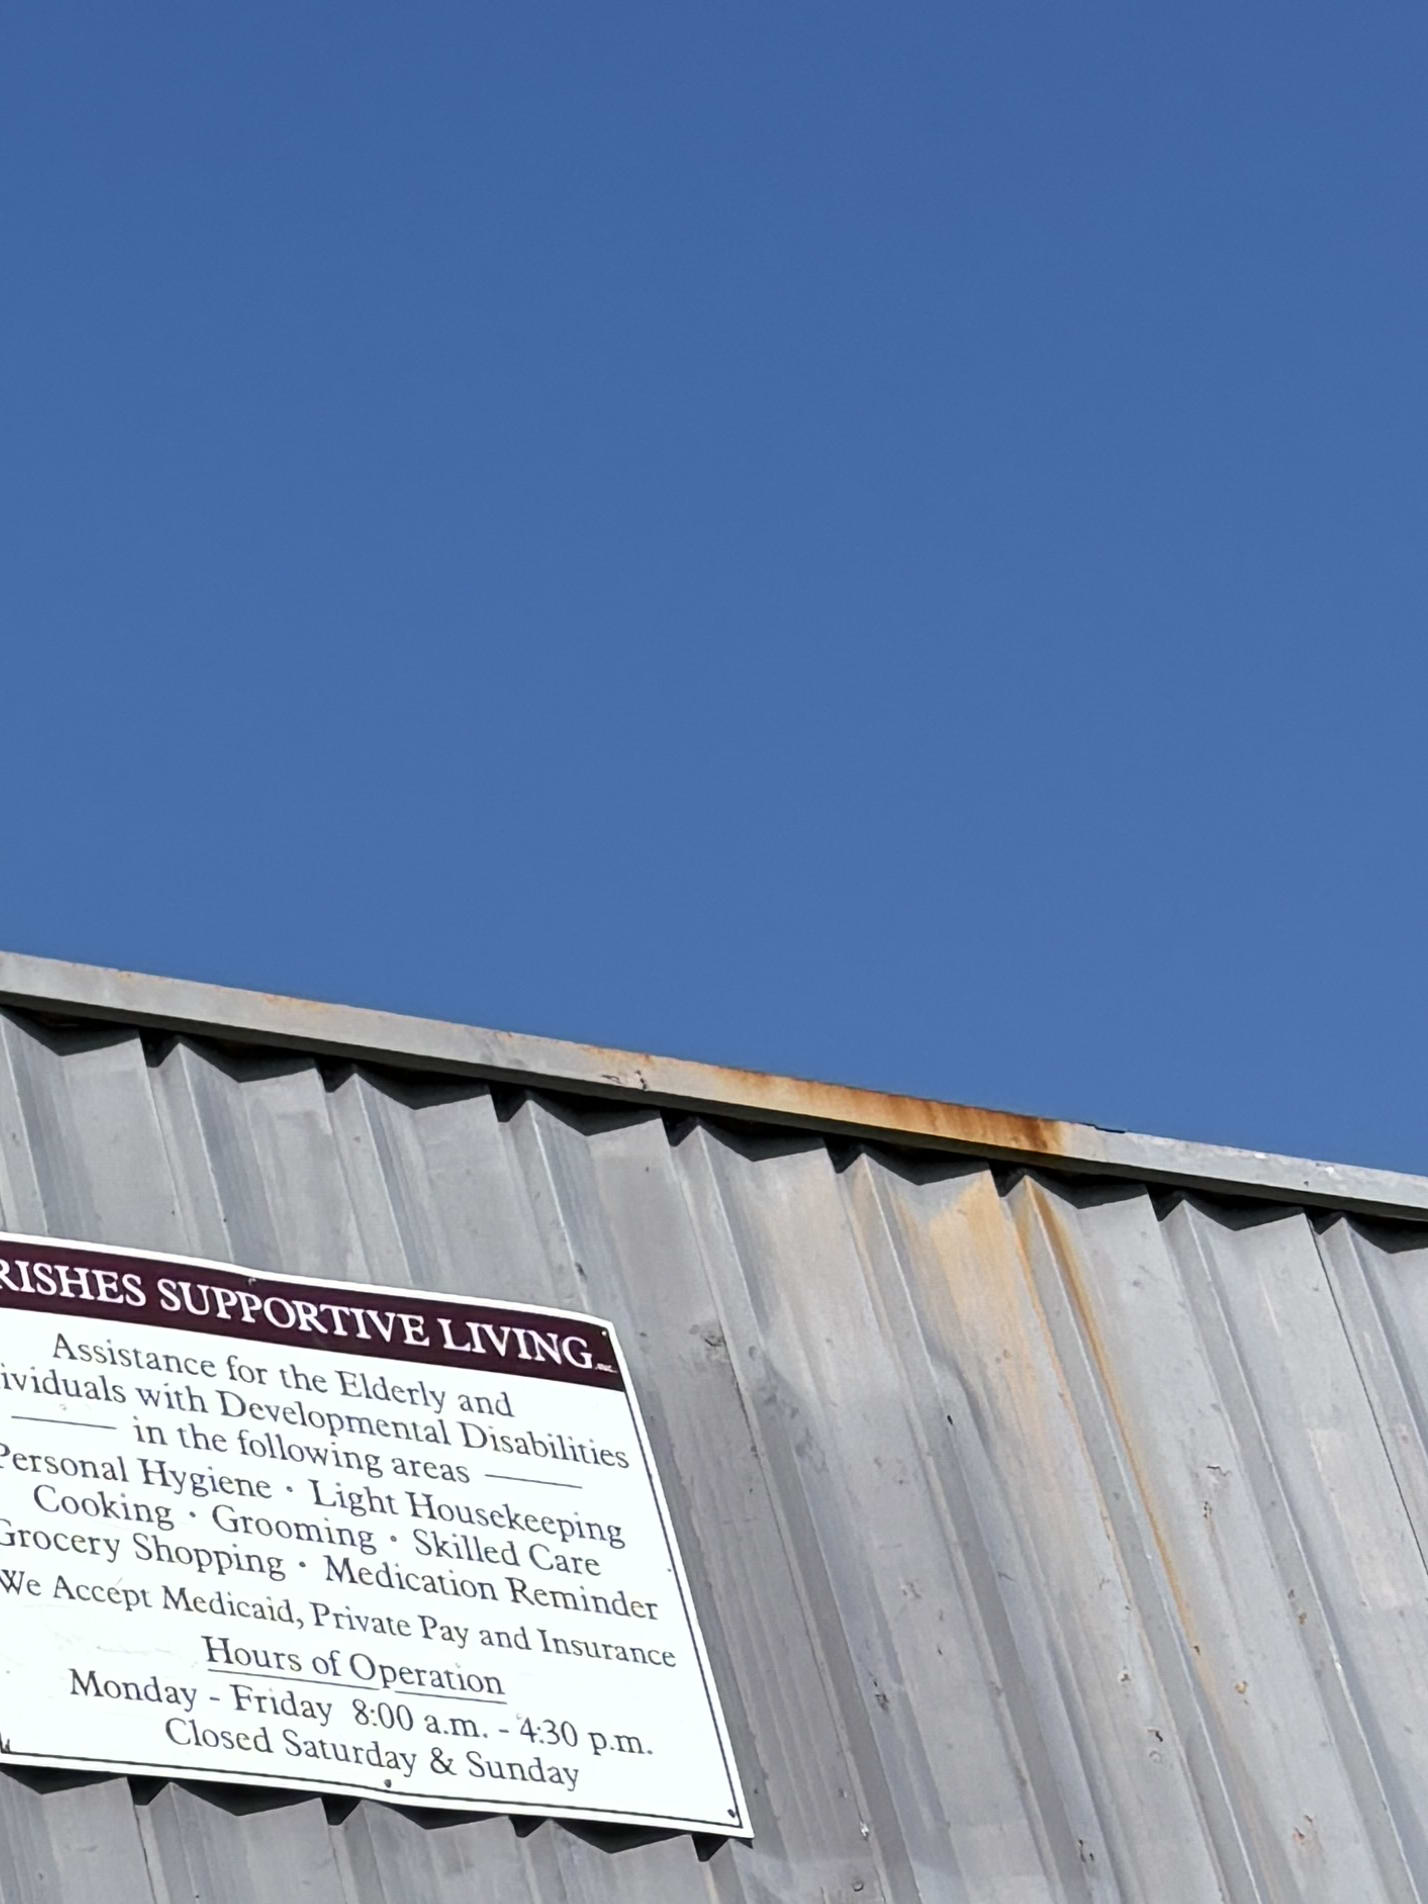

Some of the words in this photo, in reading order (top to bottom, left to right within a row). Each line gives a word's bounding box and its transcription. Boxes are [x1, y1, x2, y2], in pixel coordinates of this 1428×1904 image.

[159, 1277, 430, 1350] SUPPORTIVE
[437, 1318, 593, 1370] LIVING
[53, 1333, 217, 1381] Assistance
[226, 1352, 270, 1388] for
[278, 1359, 328, 1394] the
[336, 1372, 446, 1417] Elderly
[458, 1388, 513, 1417] and
[134, 1416, 169, 1445] in
[176, 1420, 229, 1452] the
[237, 1427, 383, 1481] following
[391, 1457, 470, 1484] areas
[135, 1380, 209, 1415] with
[219, 1391, 451, 1447] Developmental
[460, 1422, 630, 1470] Disabilities
[32, 1485, 174, 1531] Cooking
[212, 1504, 376, 1554] Grooming
[413, 1531, 520, 1571] Skilled
[527, 1542, 601, 1578] Care
[140, 1459, 271, 1501] Hygiene
[312, 1479, 399, 1521] Light
[408, 1491, 626, 1550] Housekeeping
[53, 1575, 153, 1611] Accept
[162, 1588, 304, 1630] Medicaid,
[308, 1602, 411, 1639] Private
[418, 1616, 469, 1649] Pay
[479, 1625, 532, 1652] and
[540, 1630, 676, 1668] Insurance
[133, 1533, 285, 1582] Shopping
[323, 1555, 497, 1604] Medication
[507, 1579, 658, 1623] Reminder
[201, 1636, 302, 1675] Hours
[312, 1649, 340, 1675] of
[348, 1653, 506, 1696] Operation
[69, 1669, 198, 1711] Monday
[232, 1685, 334, 1727] Friday
[352, 1701, 414, 1734] 8:00
[424, 1716, 489, 1739] a.m.
[519, 1718, 579, 1750] 4:30
[587, 1733, 654, 1759] p.m.
[165, 1719, 273, 1758] Closed
[283, 1731, 418, 1777] Saturday
[430, 1747, 456, 1774] &
[467, 1751, 580, 1790] Sunday
